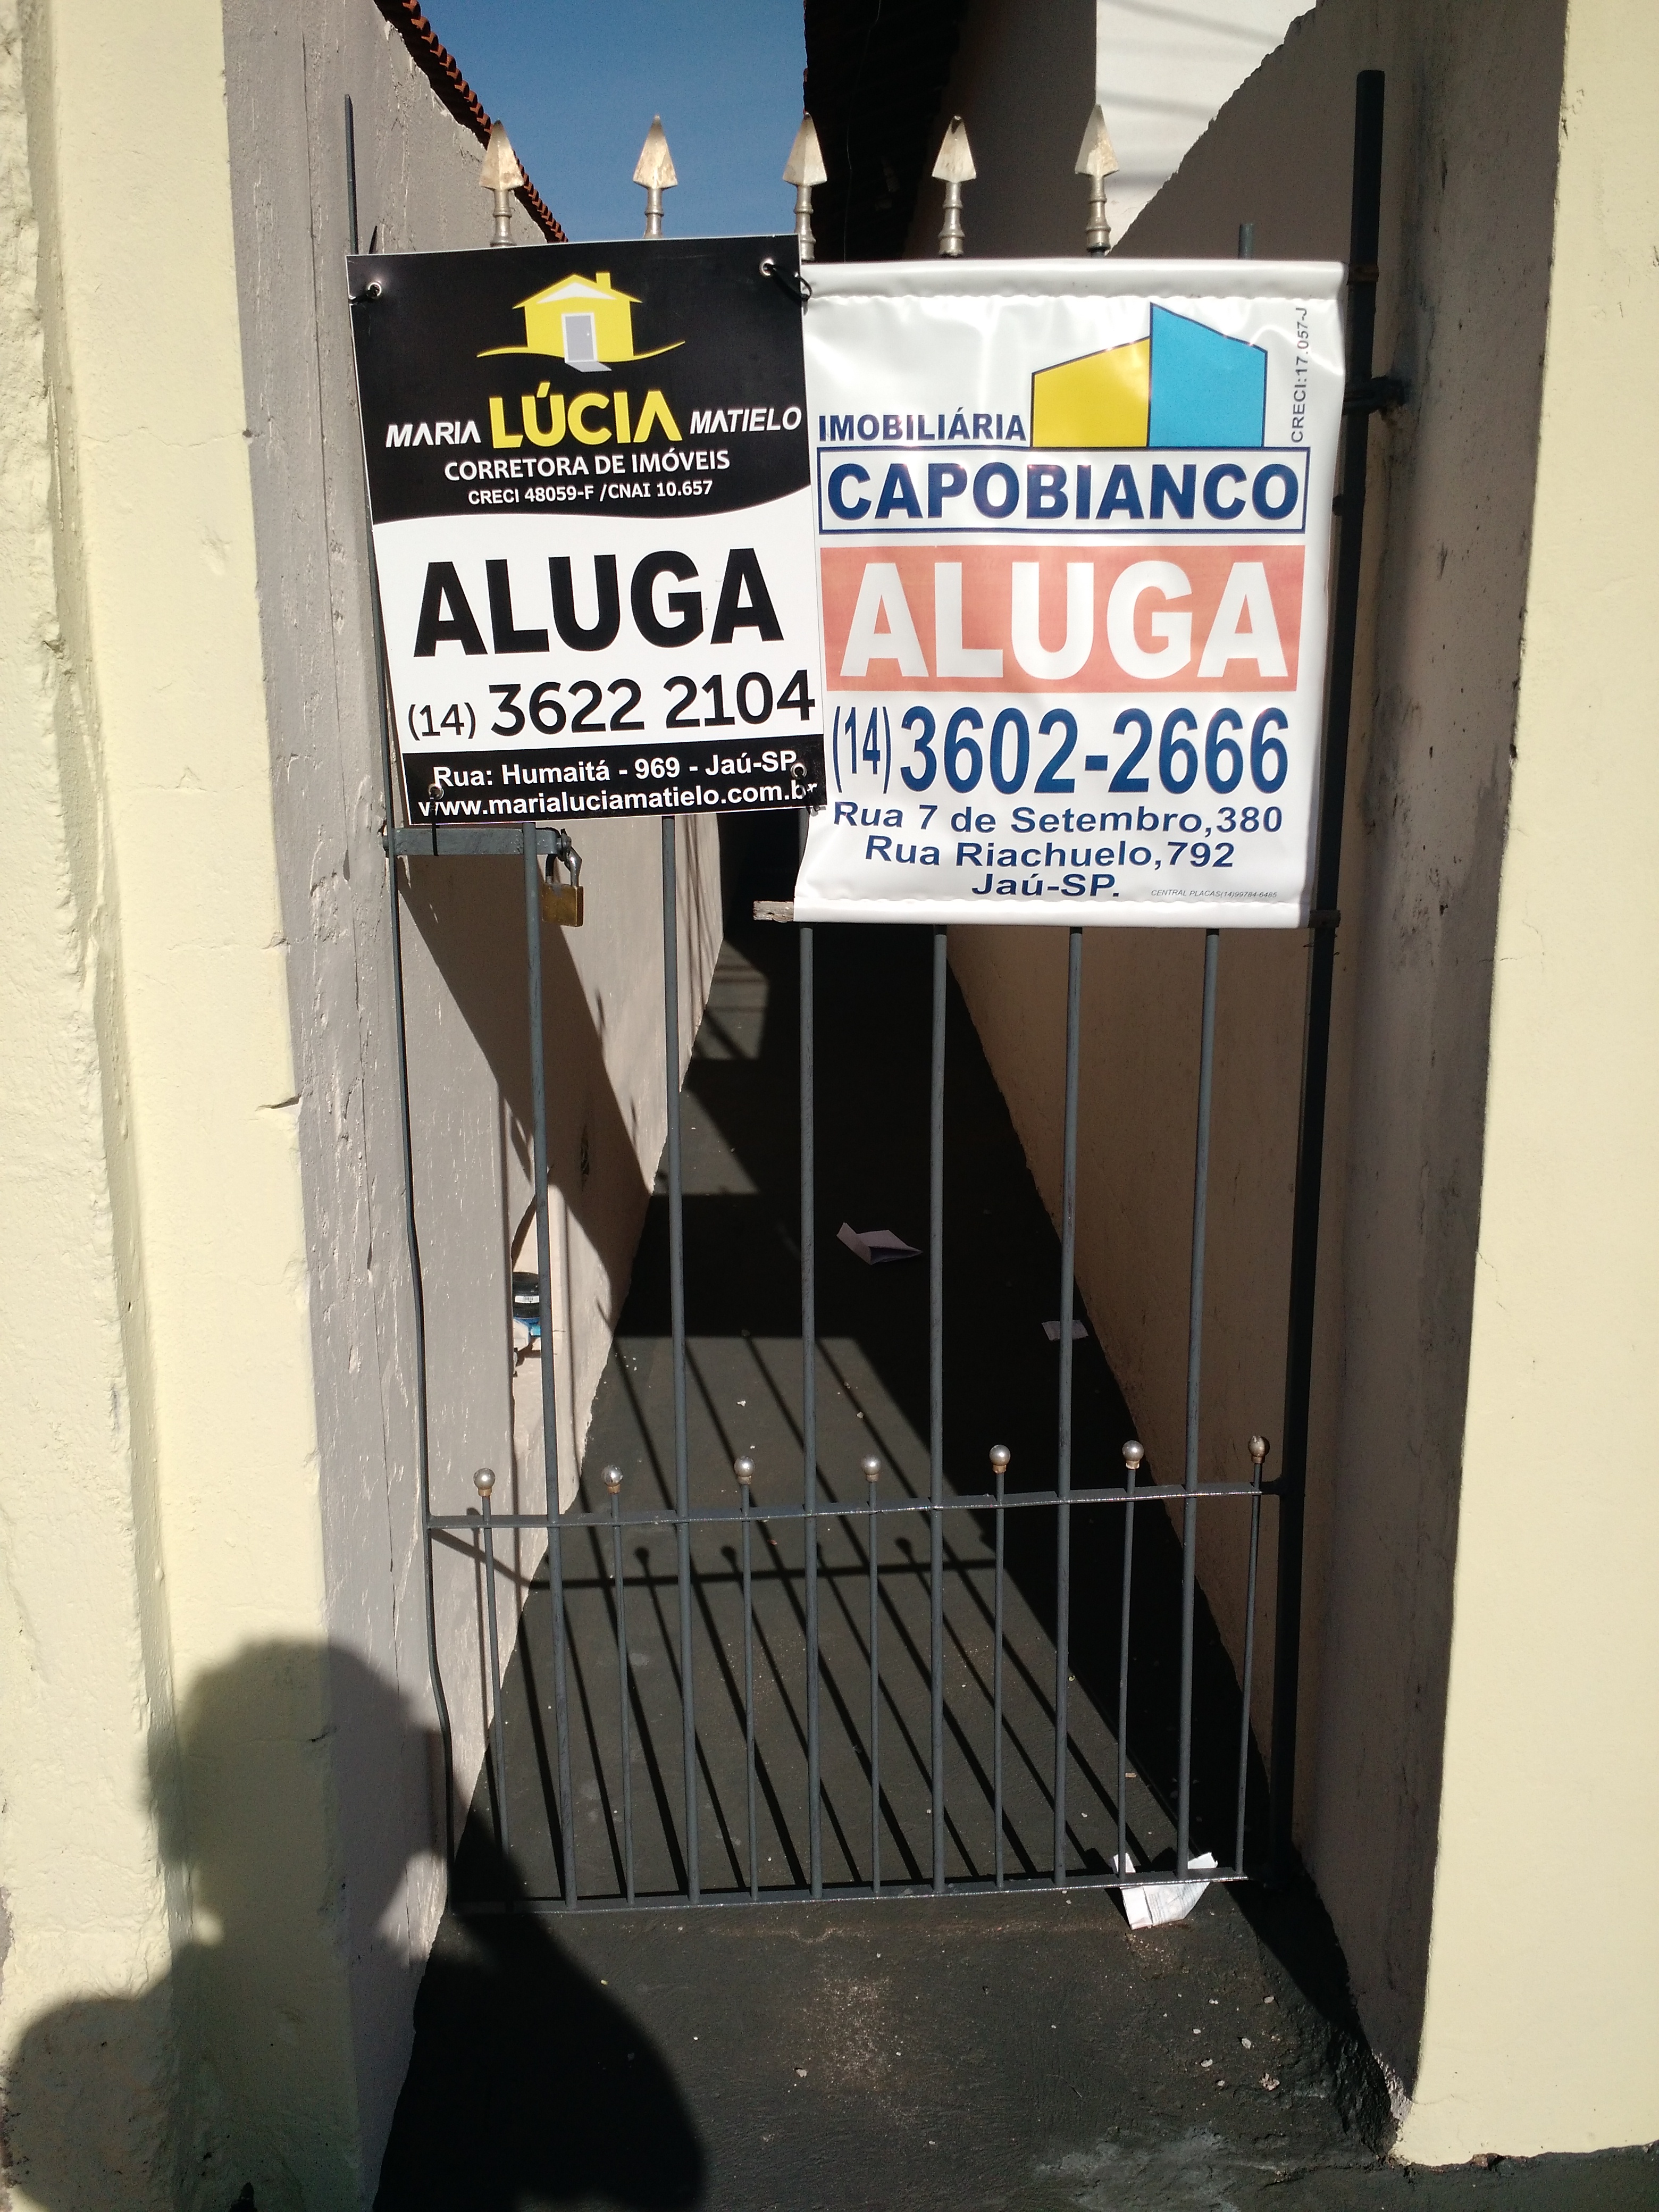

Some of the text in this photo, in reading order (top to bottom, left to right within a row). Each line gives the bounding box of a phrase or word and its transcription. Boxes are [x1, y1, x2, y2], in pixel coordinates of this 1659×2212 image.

[1291, 308, 1309, 443] CRECI:17.057-J
[386, 382, 802, 449] MARIA LÚCIA MATIELO
[818, 407, 1027, 442] IMOBILIÁRIA
[445, 448, 730, 481] CORRETORA DE IMÓVEIS
[468, 489, 520, 505] CRECI
[525, 484, 594, 502] 48059-F
[657, 480, 713, 499] 10.657
[827, 462, 1300, 521] CAPOBIANCO
[414, 548, 784, 658] ALUGA
[840, 560, 1288, 680] ALUGA
[408, 669, 816, 741] (14) 3622 2104
[433, 767, 492, 786] Rua:
[501, 760, 610, 785] Humaitá
[635, 757, 680, 780] 969
[832, 706, 1289, 795] (14) 3602-2666
[833, 801, 1283, 836] Rua 7 de Setembro,380
[865, 835, 1235, 871] Rua Riachuelo,792
[971, 873, 1121, 898] Jaú-SP.
